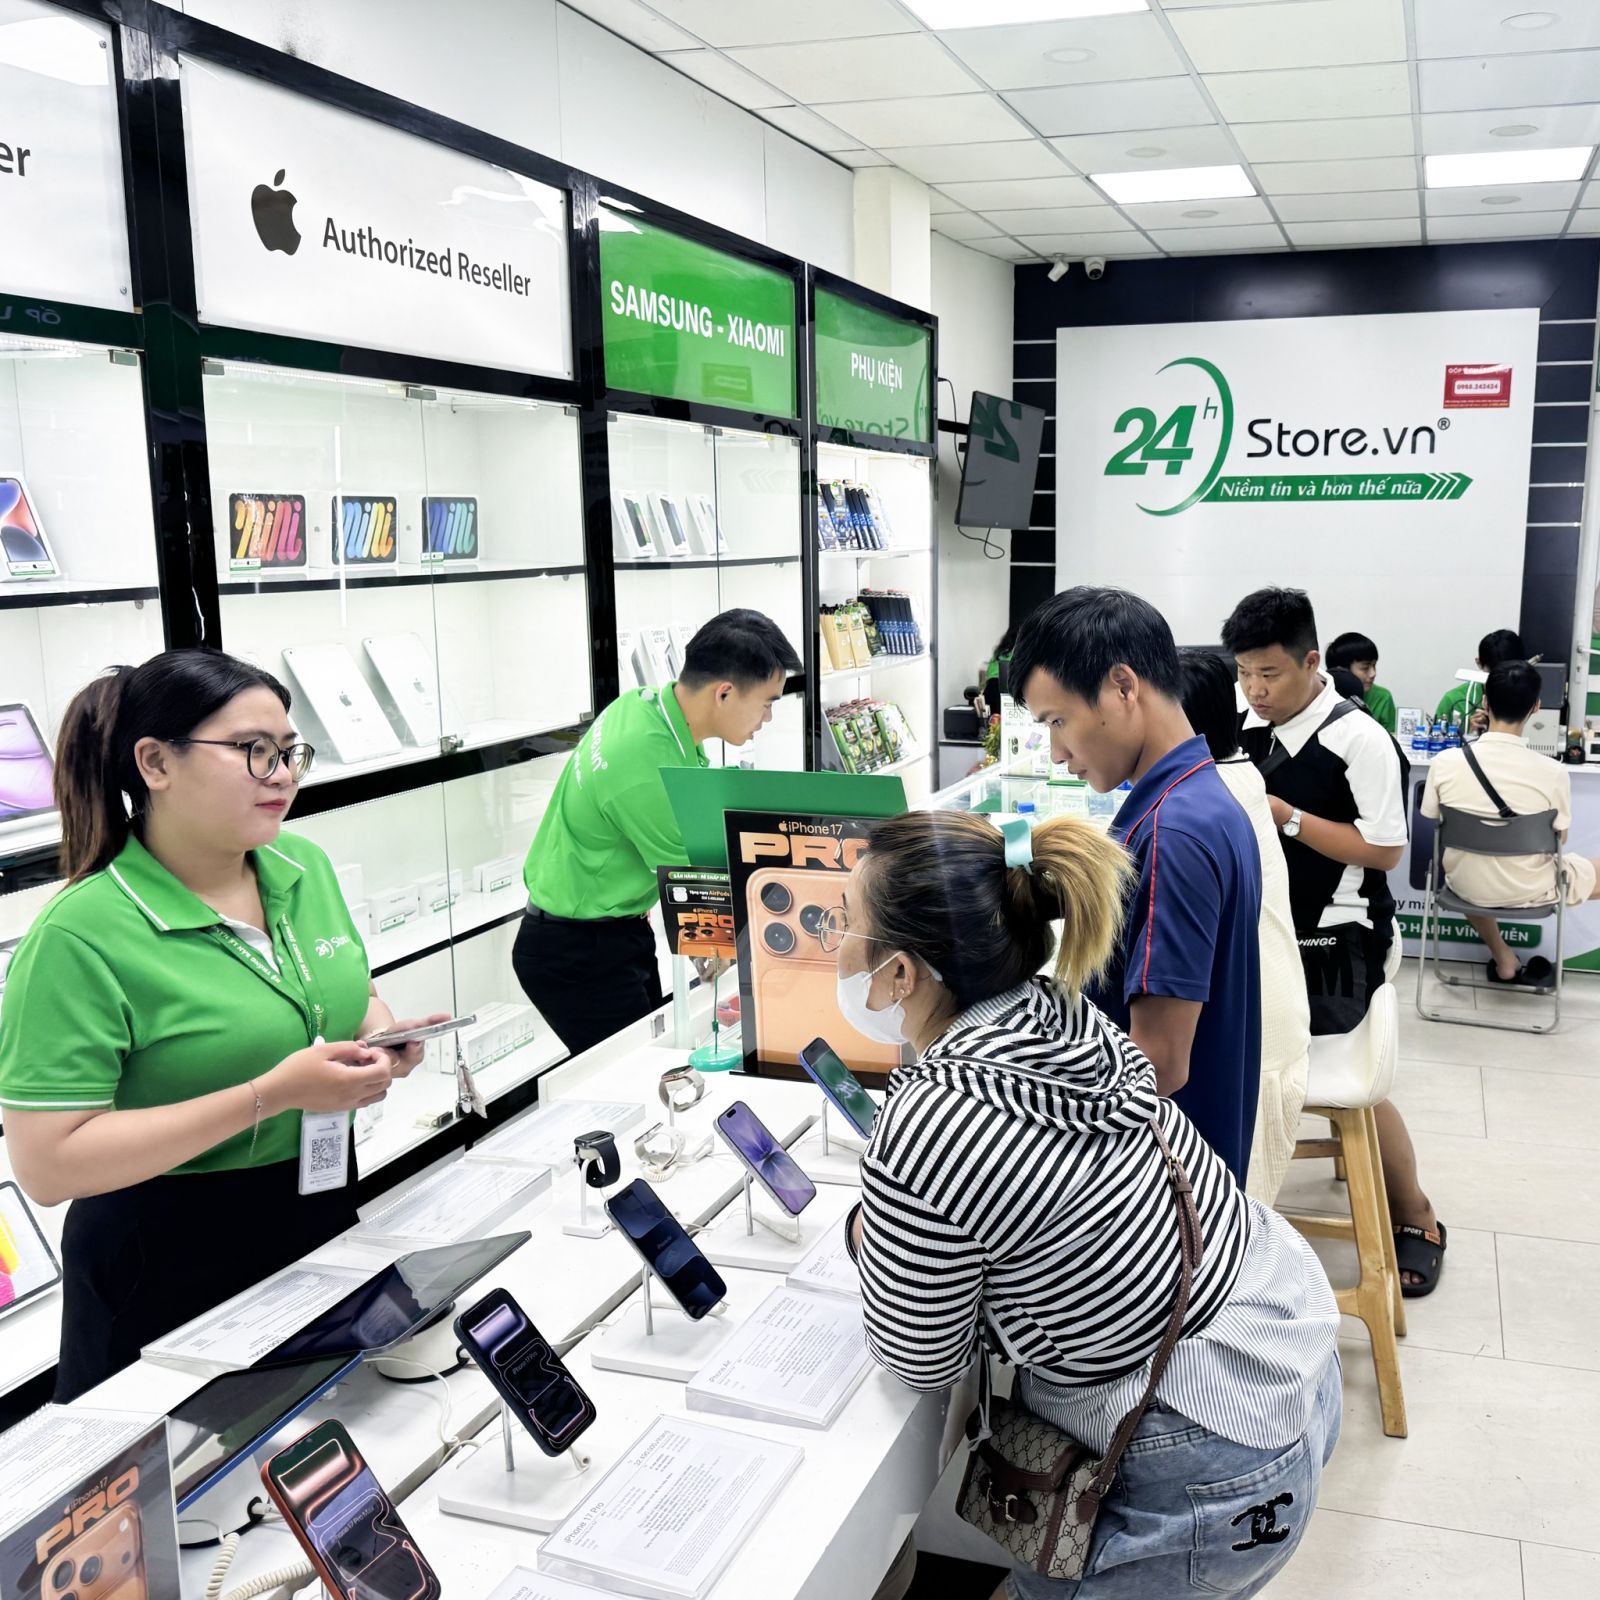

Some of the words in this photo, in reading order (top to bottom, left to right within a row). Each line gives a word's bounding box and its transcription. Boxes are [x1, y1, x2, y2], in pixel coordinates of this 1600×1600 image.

[323, 217, 452, 278] Authorized
[458, 252, 531, 296] Reseller
[610, 280, 713, 338] SAMSUNG
[727, 314, 784, 357] XIAOMI
[851, 352, 875, 389] PHỤ
[878, 357, 903, 394] KIỆN
[1219, 478, 1264, 497] Niềm
[1270, 480, 1292, 497] tin
[1298, 480, 1316, 497] và
[1321, 480, 1351, 496] hơn
[1358, 476, 1391, 496] thế
[1390, 479, 1422, 495] nữa
[788, 821, 830, 835] iPhone
[830, 823, 843, 836] 17
[35, 1465, 140, 1564] PRO
